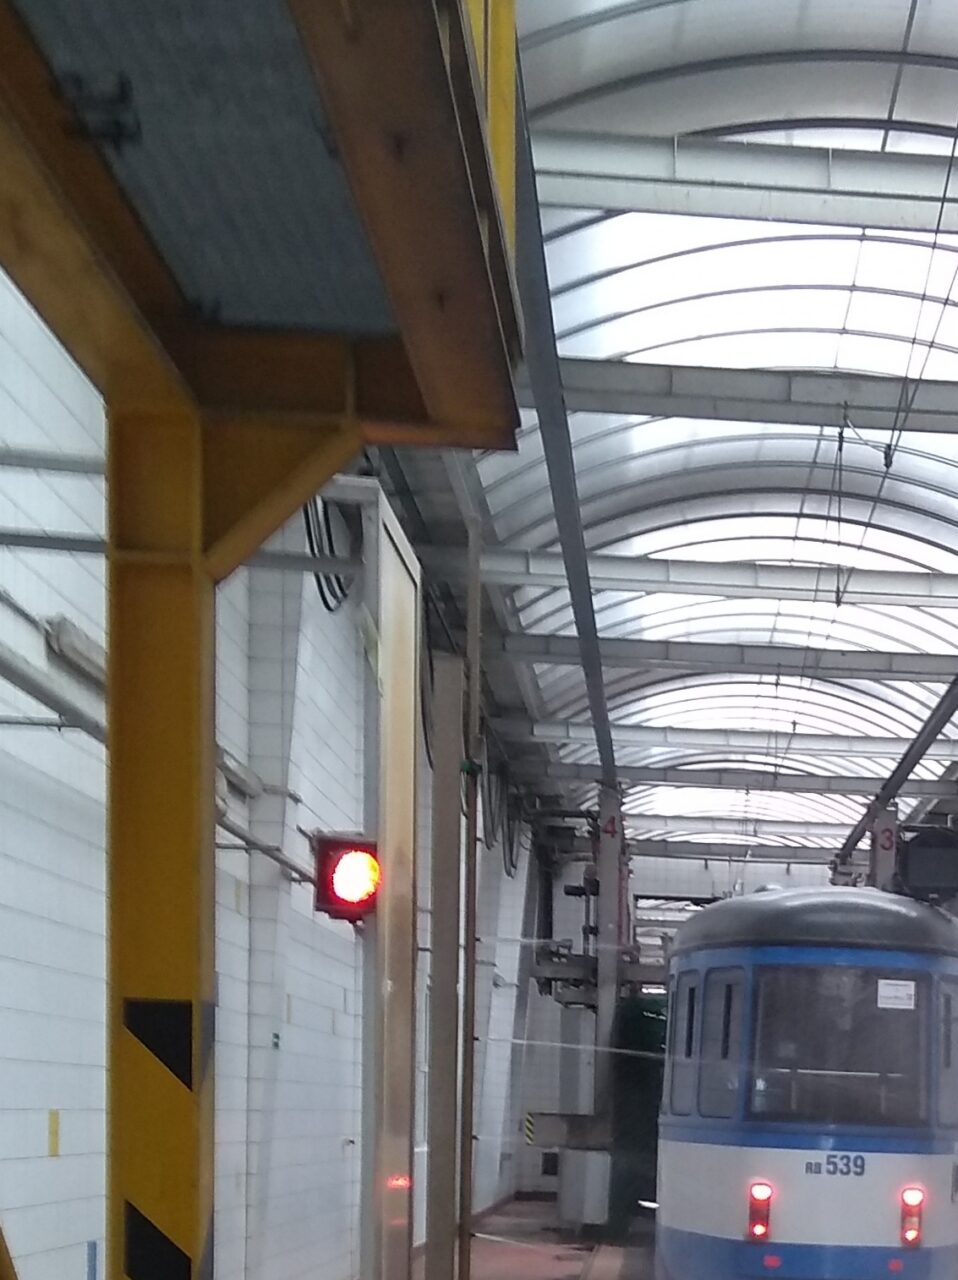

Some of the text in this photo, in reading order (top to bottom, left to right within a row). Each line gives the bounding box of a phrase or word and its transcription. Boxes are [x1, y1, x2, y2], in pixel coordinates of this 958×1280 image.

[602, 815, 618, 838] 4
[880, 828, 894, 851] 3
[826, 1154, 865, 1176] 539
